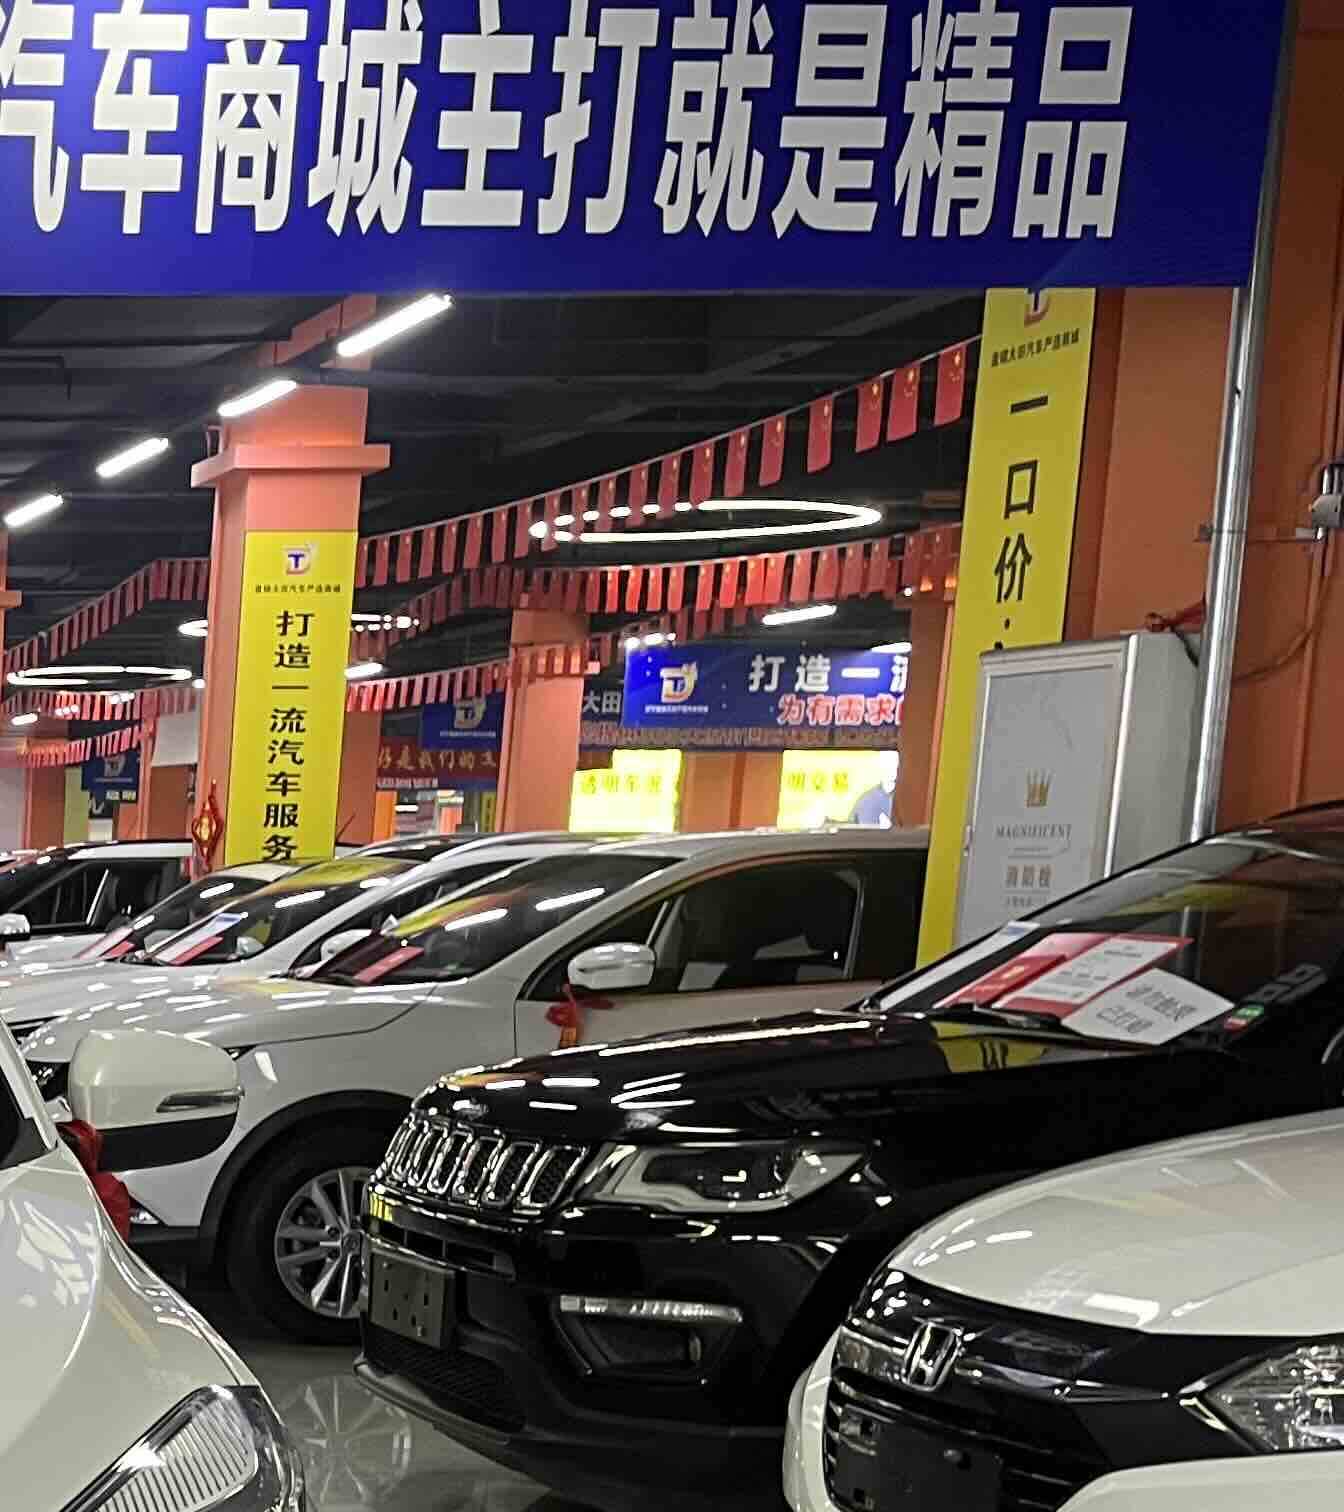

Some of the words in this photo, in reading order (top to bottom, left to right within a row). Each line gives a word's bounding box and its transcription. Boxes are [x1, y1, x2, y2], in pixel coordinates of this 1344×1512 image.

[262, 610, 315, 862] 打造一流汽车服务
[776, 694, 904, 726] 为有需求
